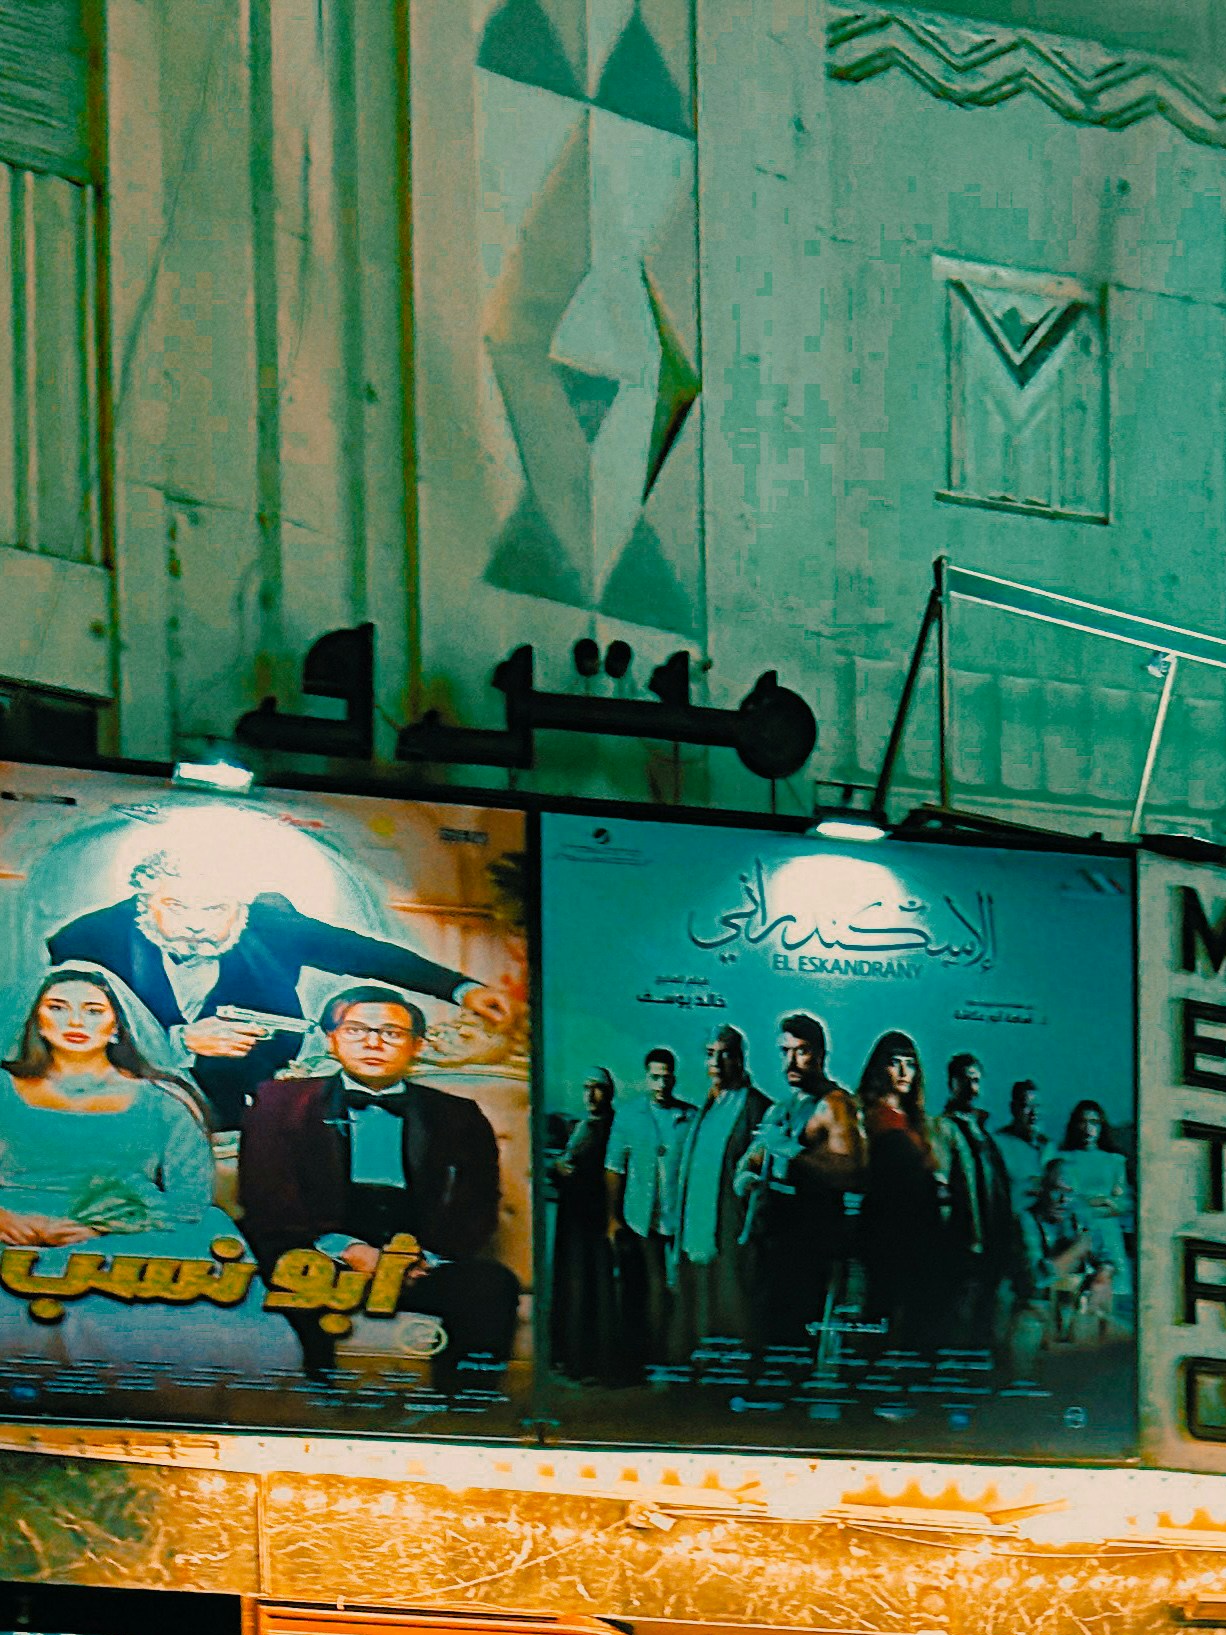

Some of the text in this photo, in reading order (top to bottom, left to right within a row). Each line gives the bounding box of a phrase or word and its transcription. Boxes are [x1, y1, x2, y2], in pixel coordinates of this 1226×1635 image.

[773, 953, 924, 979] EL ESKANDRANY
[1, 1234, 421, 1337] أبو نسب
